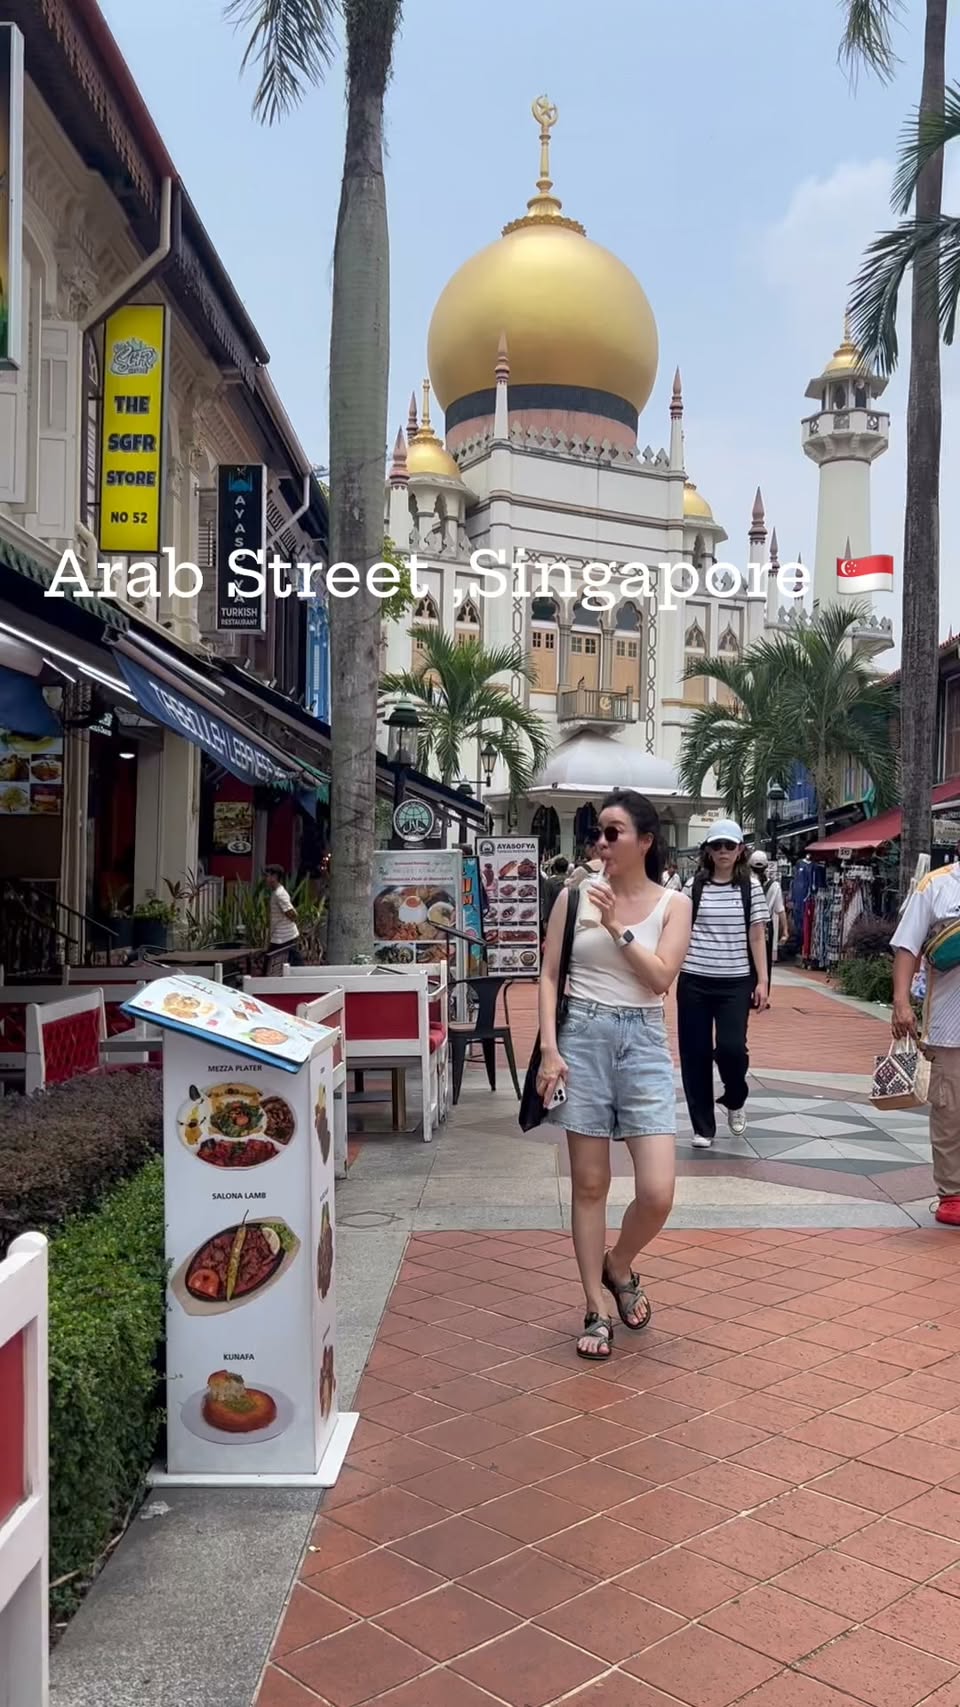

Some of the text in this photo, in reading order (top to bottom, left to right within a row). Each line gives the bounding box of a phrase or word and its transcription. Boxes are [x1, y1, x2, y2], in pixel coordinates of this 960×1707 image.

[114, 395, 150, 414] THE
[107, 433, 156, 452] SGFR
[106, 471, 156, 487] STORE
[111, 511, 148, 523] NO 52
[221, 607, 258, 617] TURKISH
[221, 618, 258, 626] RESTAURANT
[207, 1064, 263, 1073] MEZZA PLATER
[211, 1191, 267, 1200] SALONA LAMB
[223, 1353, 256, 1361] KUNAFA
